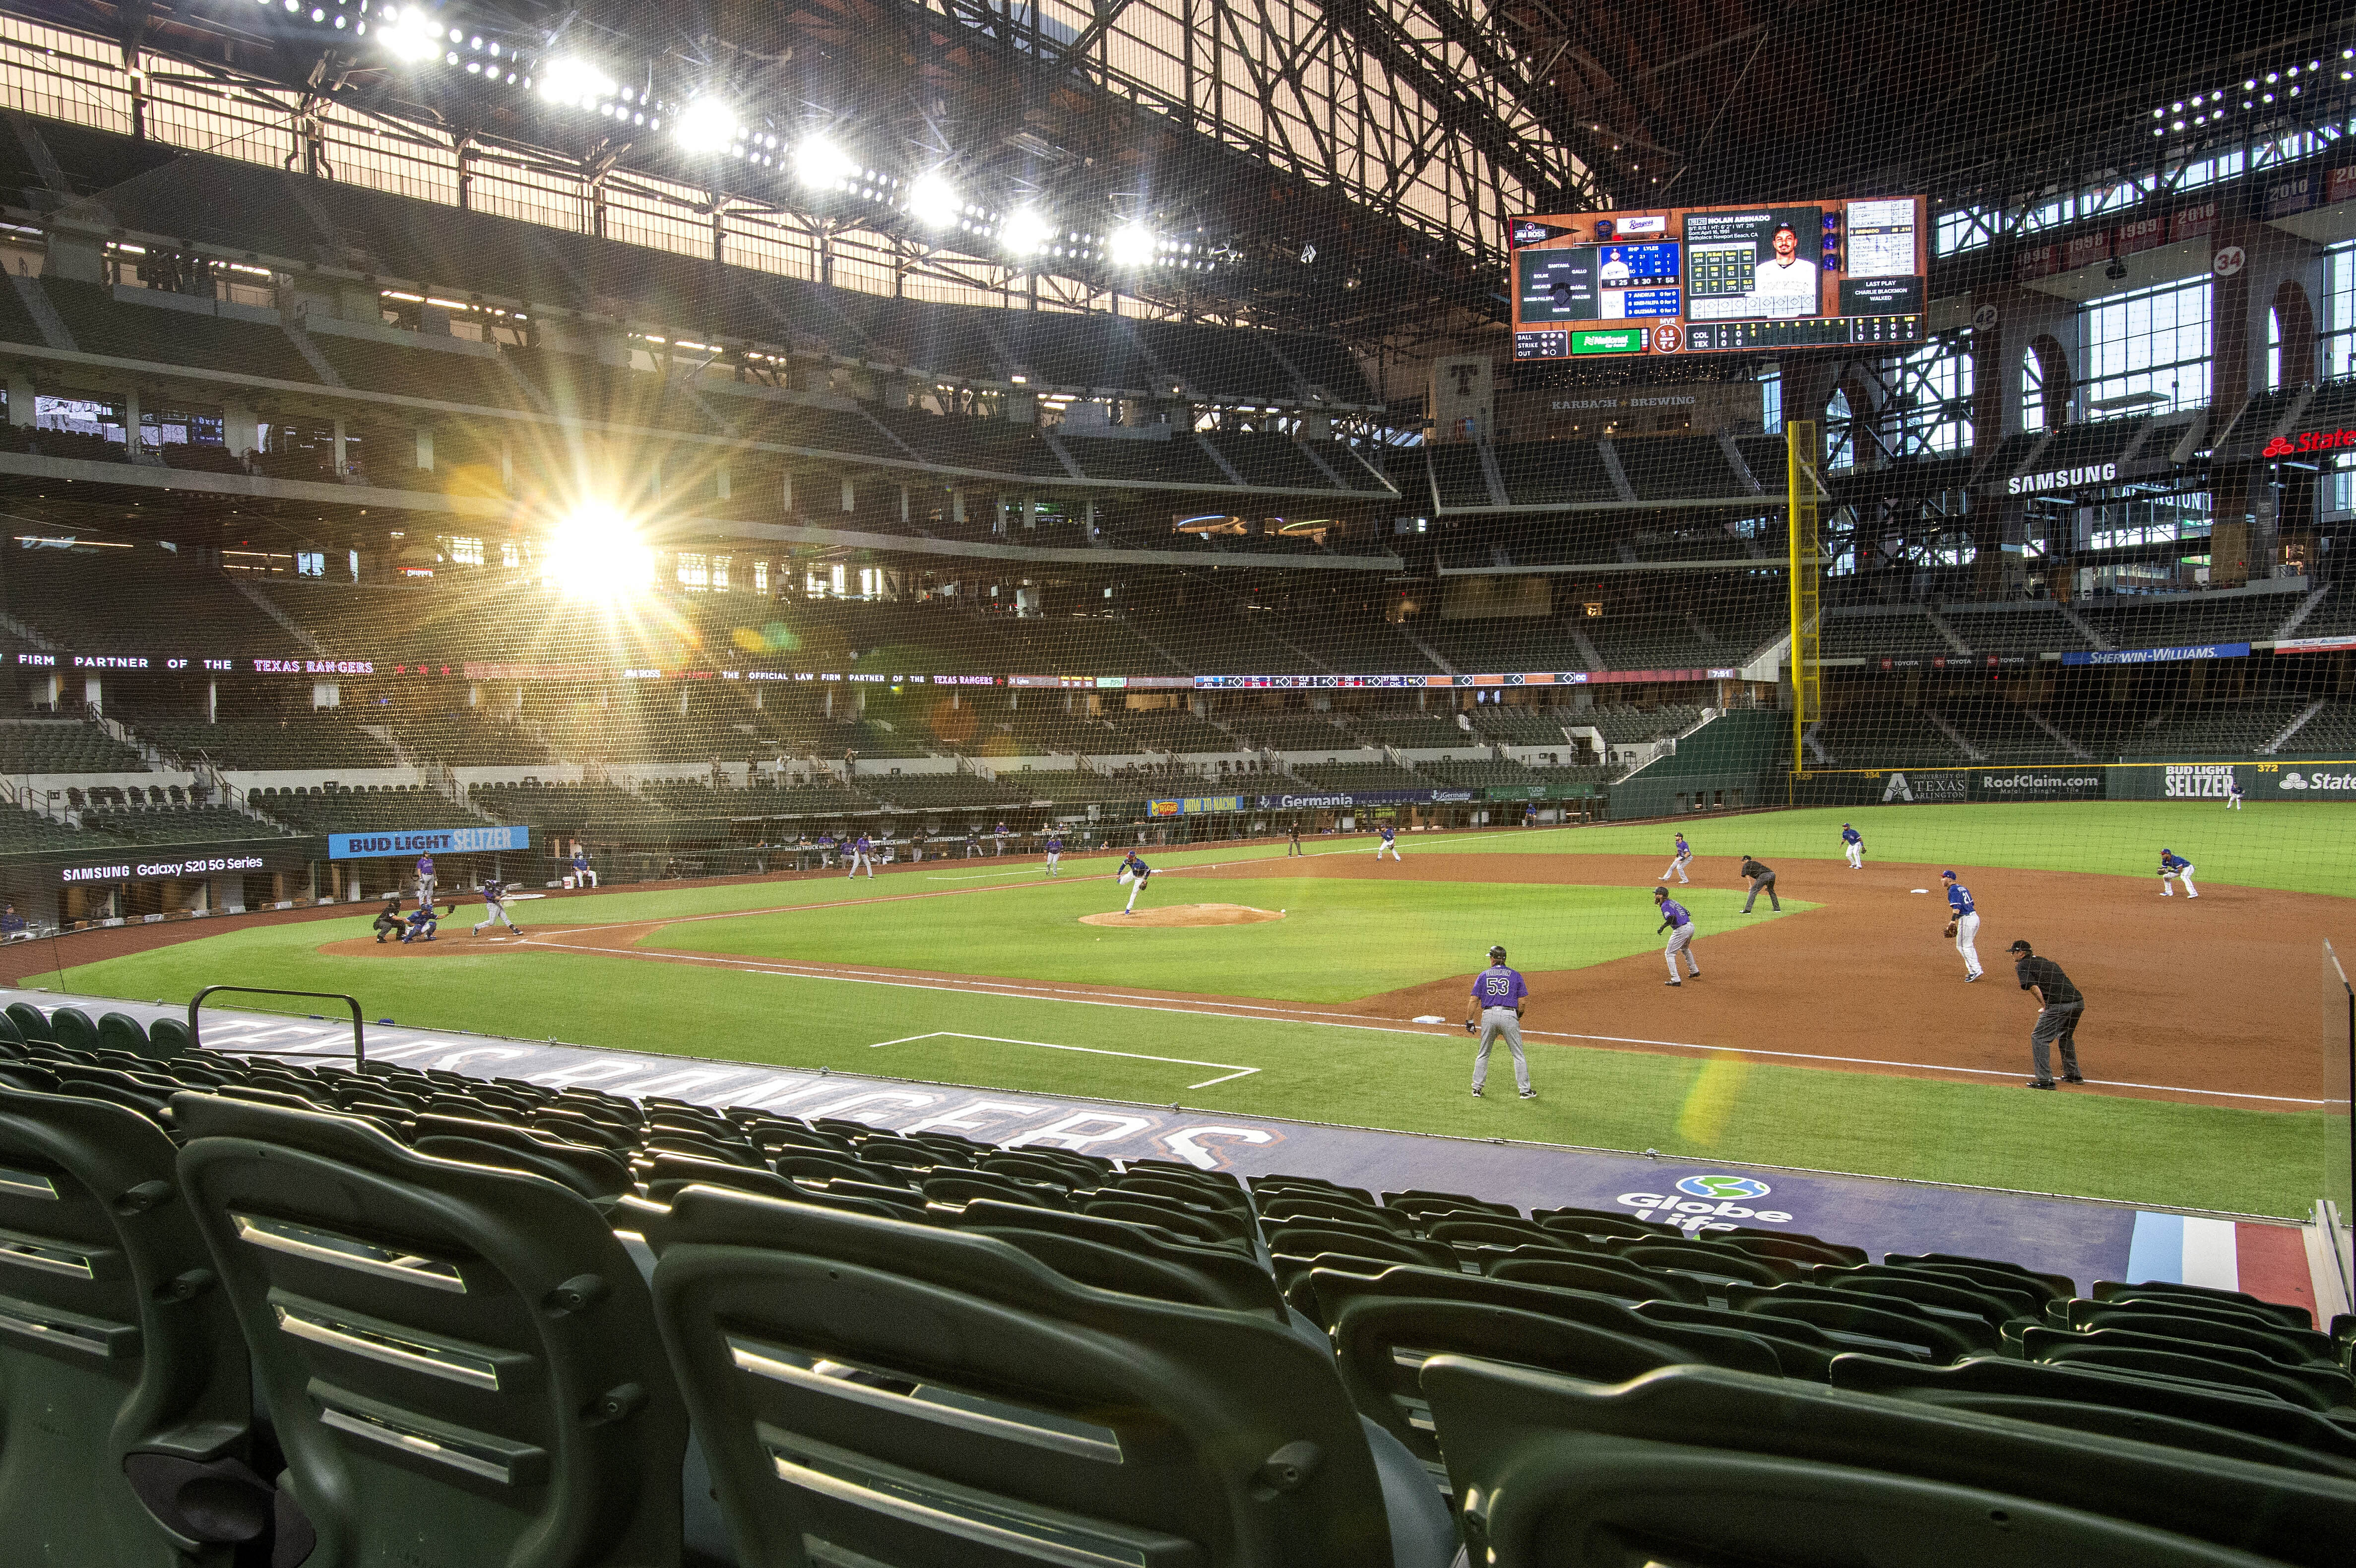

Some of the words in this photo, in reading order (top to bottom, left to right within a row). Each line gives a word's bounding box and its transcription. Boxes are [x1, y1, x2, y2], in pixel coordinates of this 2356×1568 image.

[1629, 220, 1654, 230] Rangers
[2120, 220, 2157, 239] 1999
[2218, 251, 2240, 271] 34
[1593, 335, 1628, 344] National
[1552, 399, 1617, 409] KARBACH
[1631, 396, 1695, 407] BREWING
[2297, 428, 2356, 451] State
[2008, 463, 2115, 495] SAMSUNG
[18, 654, 55, 666] FIRM
[74, 657, 148, 668] PARTNER
[167, 659, 188, 668] OF
[203, 660, 232, 670] THE
[254, 659, 300, 672] TEXAS
[306, 661, 374, 673] RANGERS
[639, 670, 660, 678] ROSS
[748, 672, 788, 680] OFFICIAL
[933, 675, 957, 684] TEXAS
[959, 676, 993, 685] RANGERS
[2166, 766, 2193, 775] BUD
[2194, 765, 2234, 775] LIGHT
[1914, 780, 1965, 791] TEXAS
[1984, 774, 2099, 788] RoofClaim.com
[2165, 775, 2234, 797] SELTZER
[2310, 773, 2356, 790] State
[1184, 799, 1200, 812] HOW
[1203, 798, 1211, 811] TO
[1213, 797, 1236, 811] NACHO
[1281, 793, 1353, 808] Germania
[349, 837, 390, 853] BUD
[394, 834, 450, 851] LIGHT
[452, 828, 512, 852] SELTZER
[63, 866, 129, 881] SAMSUNG
[136, 863, 183, 878] Galaxy
[185, 861, 206, 873] S20
[208, 859, 225, 871] 5G
[227, 856, 263, 869] Series
[1962, 892, 1974, 904] 21
[1486, 978, 1510, 996] 53
[1616, 1192, 1793, 1223] Globe
